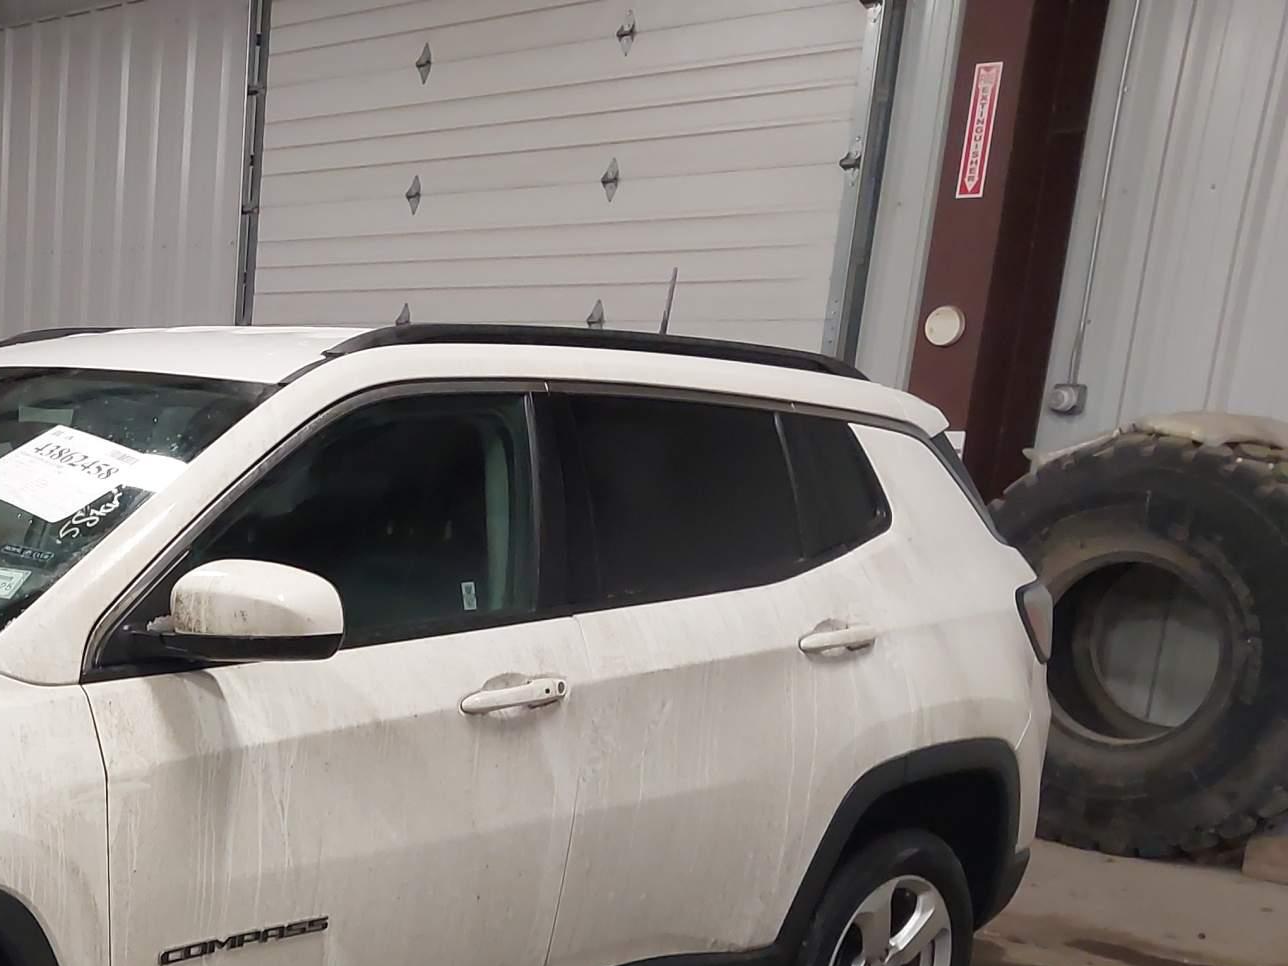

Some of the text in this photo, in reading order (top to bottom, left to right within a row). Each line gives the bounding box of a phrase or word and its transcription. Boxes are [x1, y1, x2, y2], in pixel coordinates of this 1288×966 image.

[967, 86, 990, 183] EXTINGUISHER
[34, 442, 119, 480] 43862458
[159, 915, 329, 966] COMPASS
